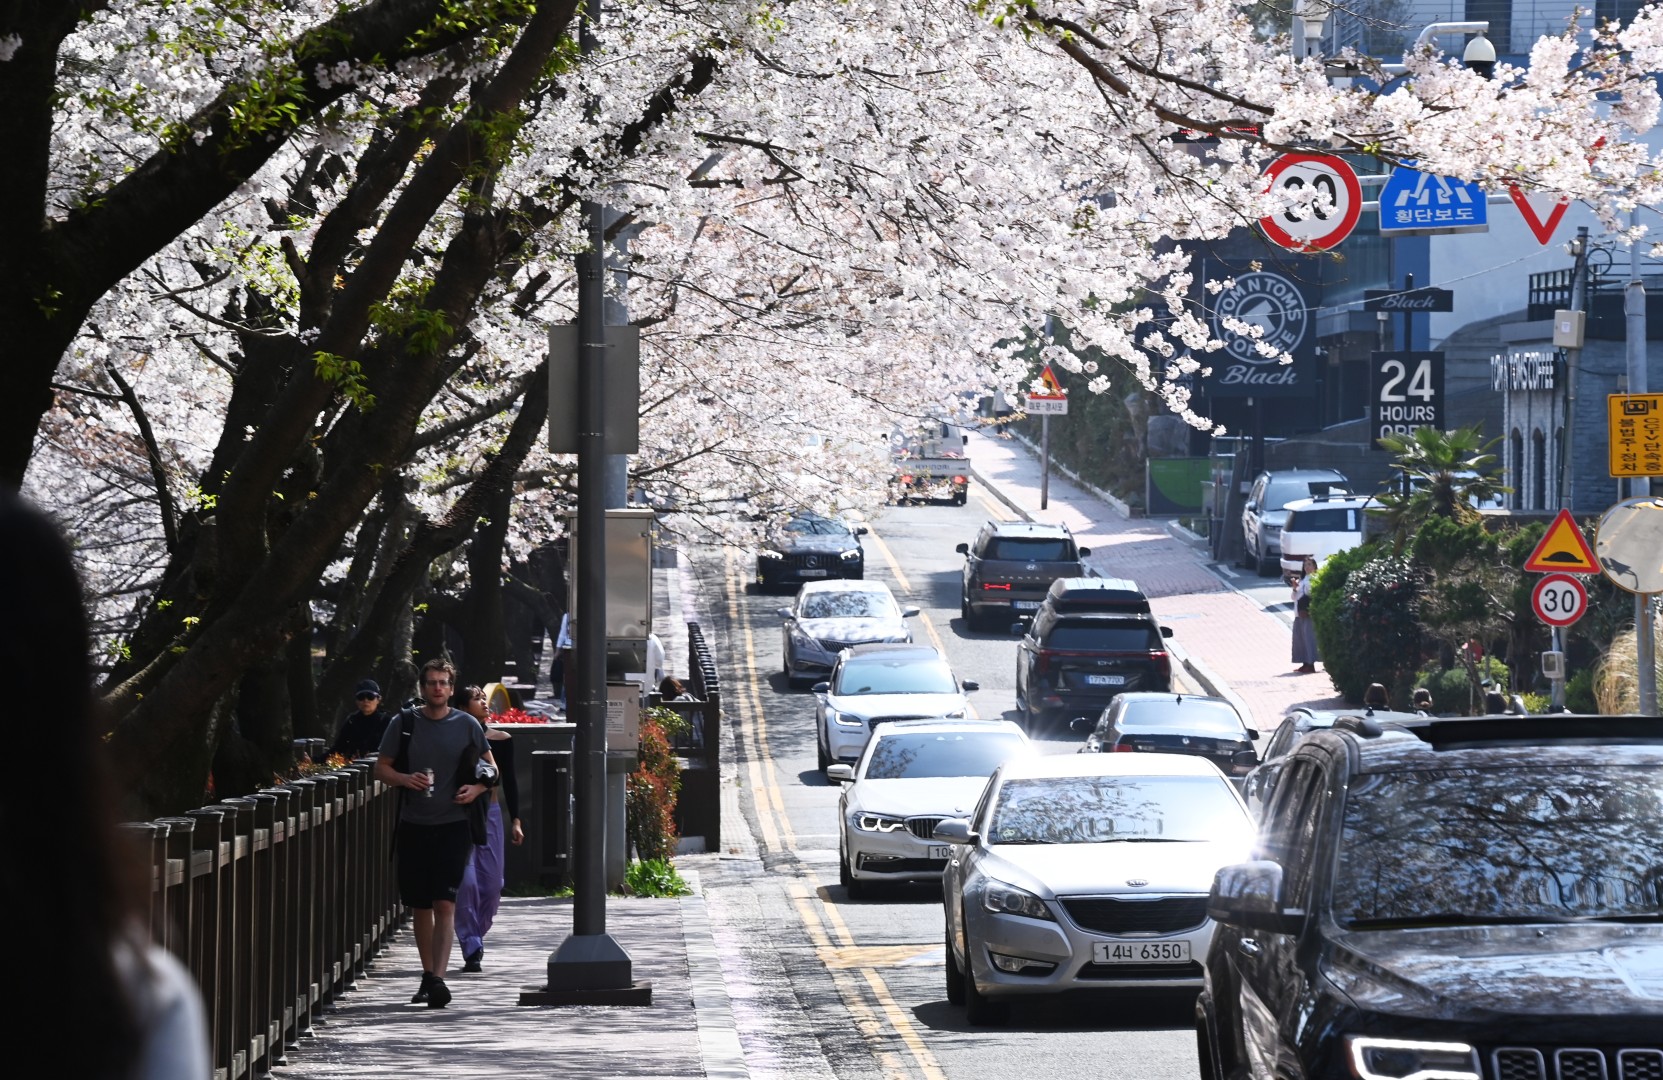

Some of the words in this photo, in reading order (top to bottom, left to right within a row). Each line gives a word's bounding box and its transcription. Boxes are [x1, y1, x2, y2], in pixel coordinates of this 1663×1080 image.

[1394, 207, 1475, 224] 횡단보도
[1247, 278, 1261, 292] N
[1264, 278, 1302, 322] TOMS
[1380, 293, 1436, 309] Black
[1224, 329, 1297, 357] COFEE
[1219, 364, 1298, 385] Black
[1380, 359, 1435, 402] 24
[1379, 405, 1435, 421] HOURS
[1380, 424, 1435, 439] OPE
[1544, 589, 1575, 613] 30
[1102, 944, 1133, 960] 14너
[1140, 943, 1182, 960] 6350
